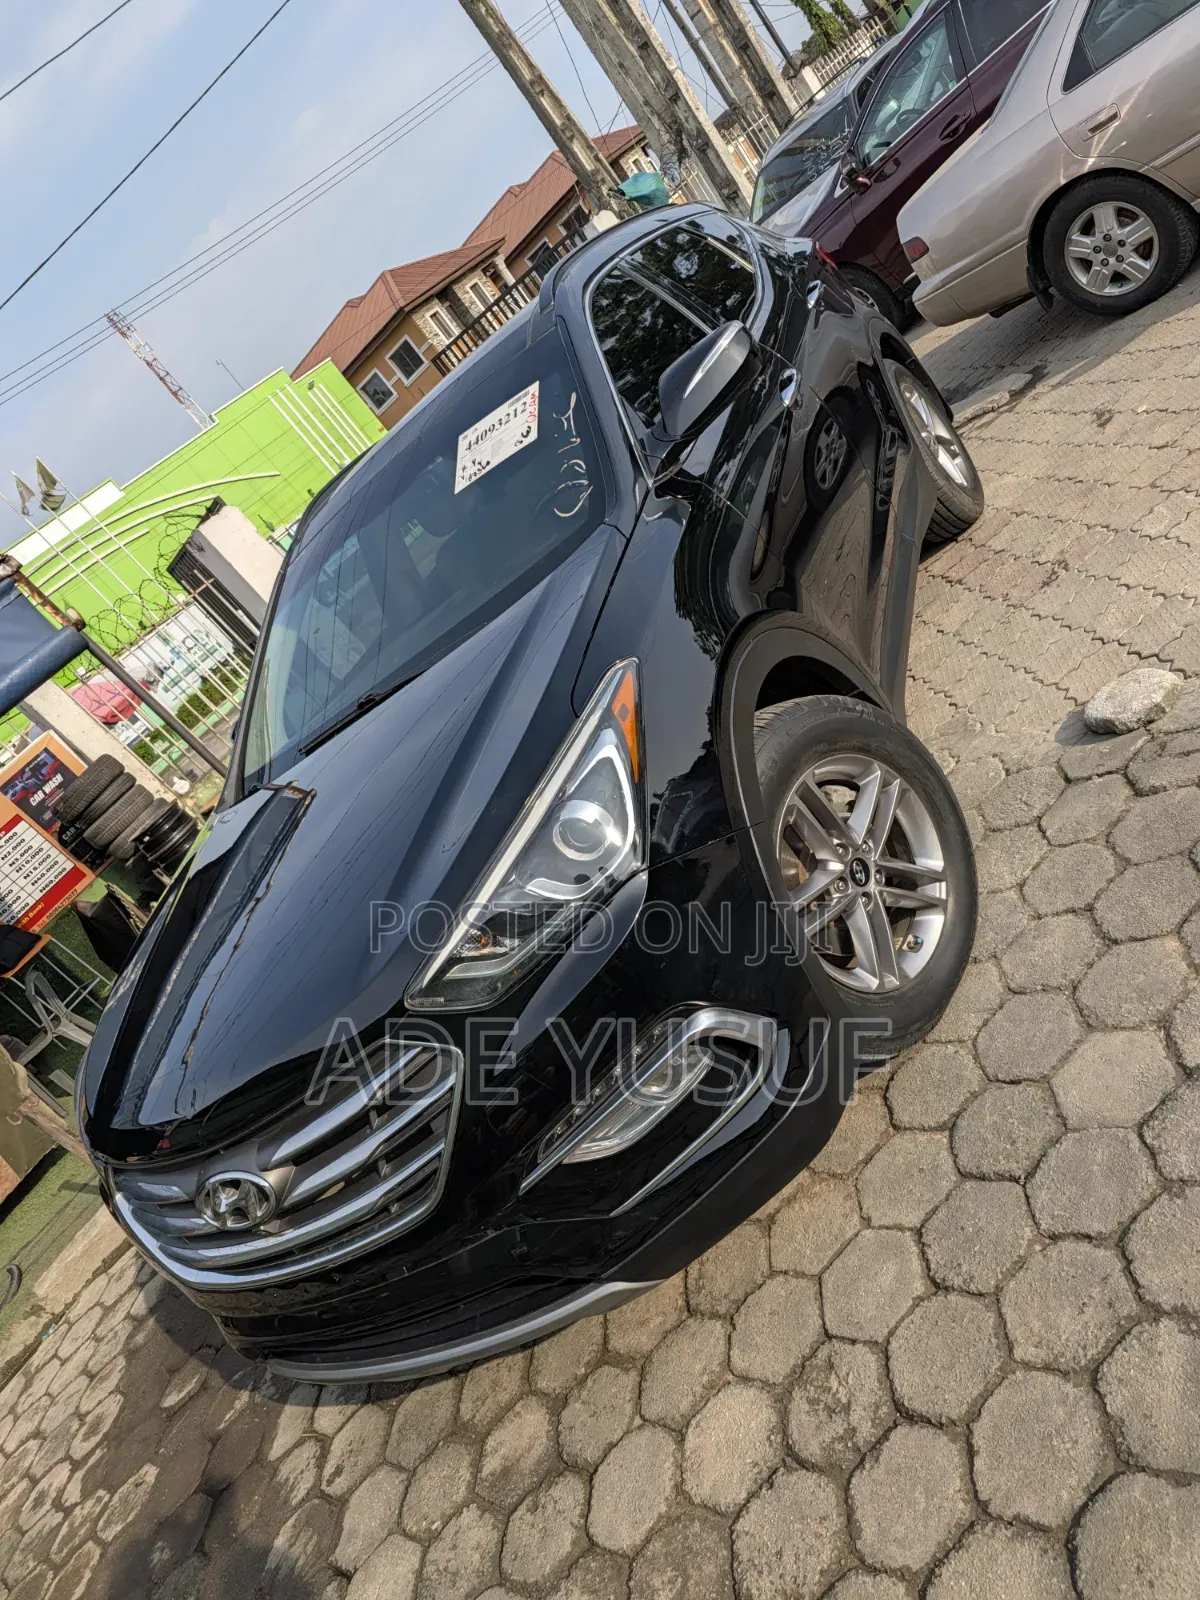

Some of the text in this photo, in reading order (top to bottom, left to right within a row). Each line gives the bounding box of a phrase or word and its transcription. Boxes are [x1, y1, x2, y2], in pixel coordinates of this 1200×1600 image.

[465, 401, 527, 451] 44093212
[29, 790, 45, 806] CAR
[42, 773, 64, 794] WASH
